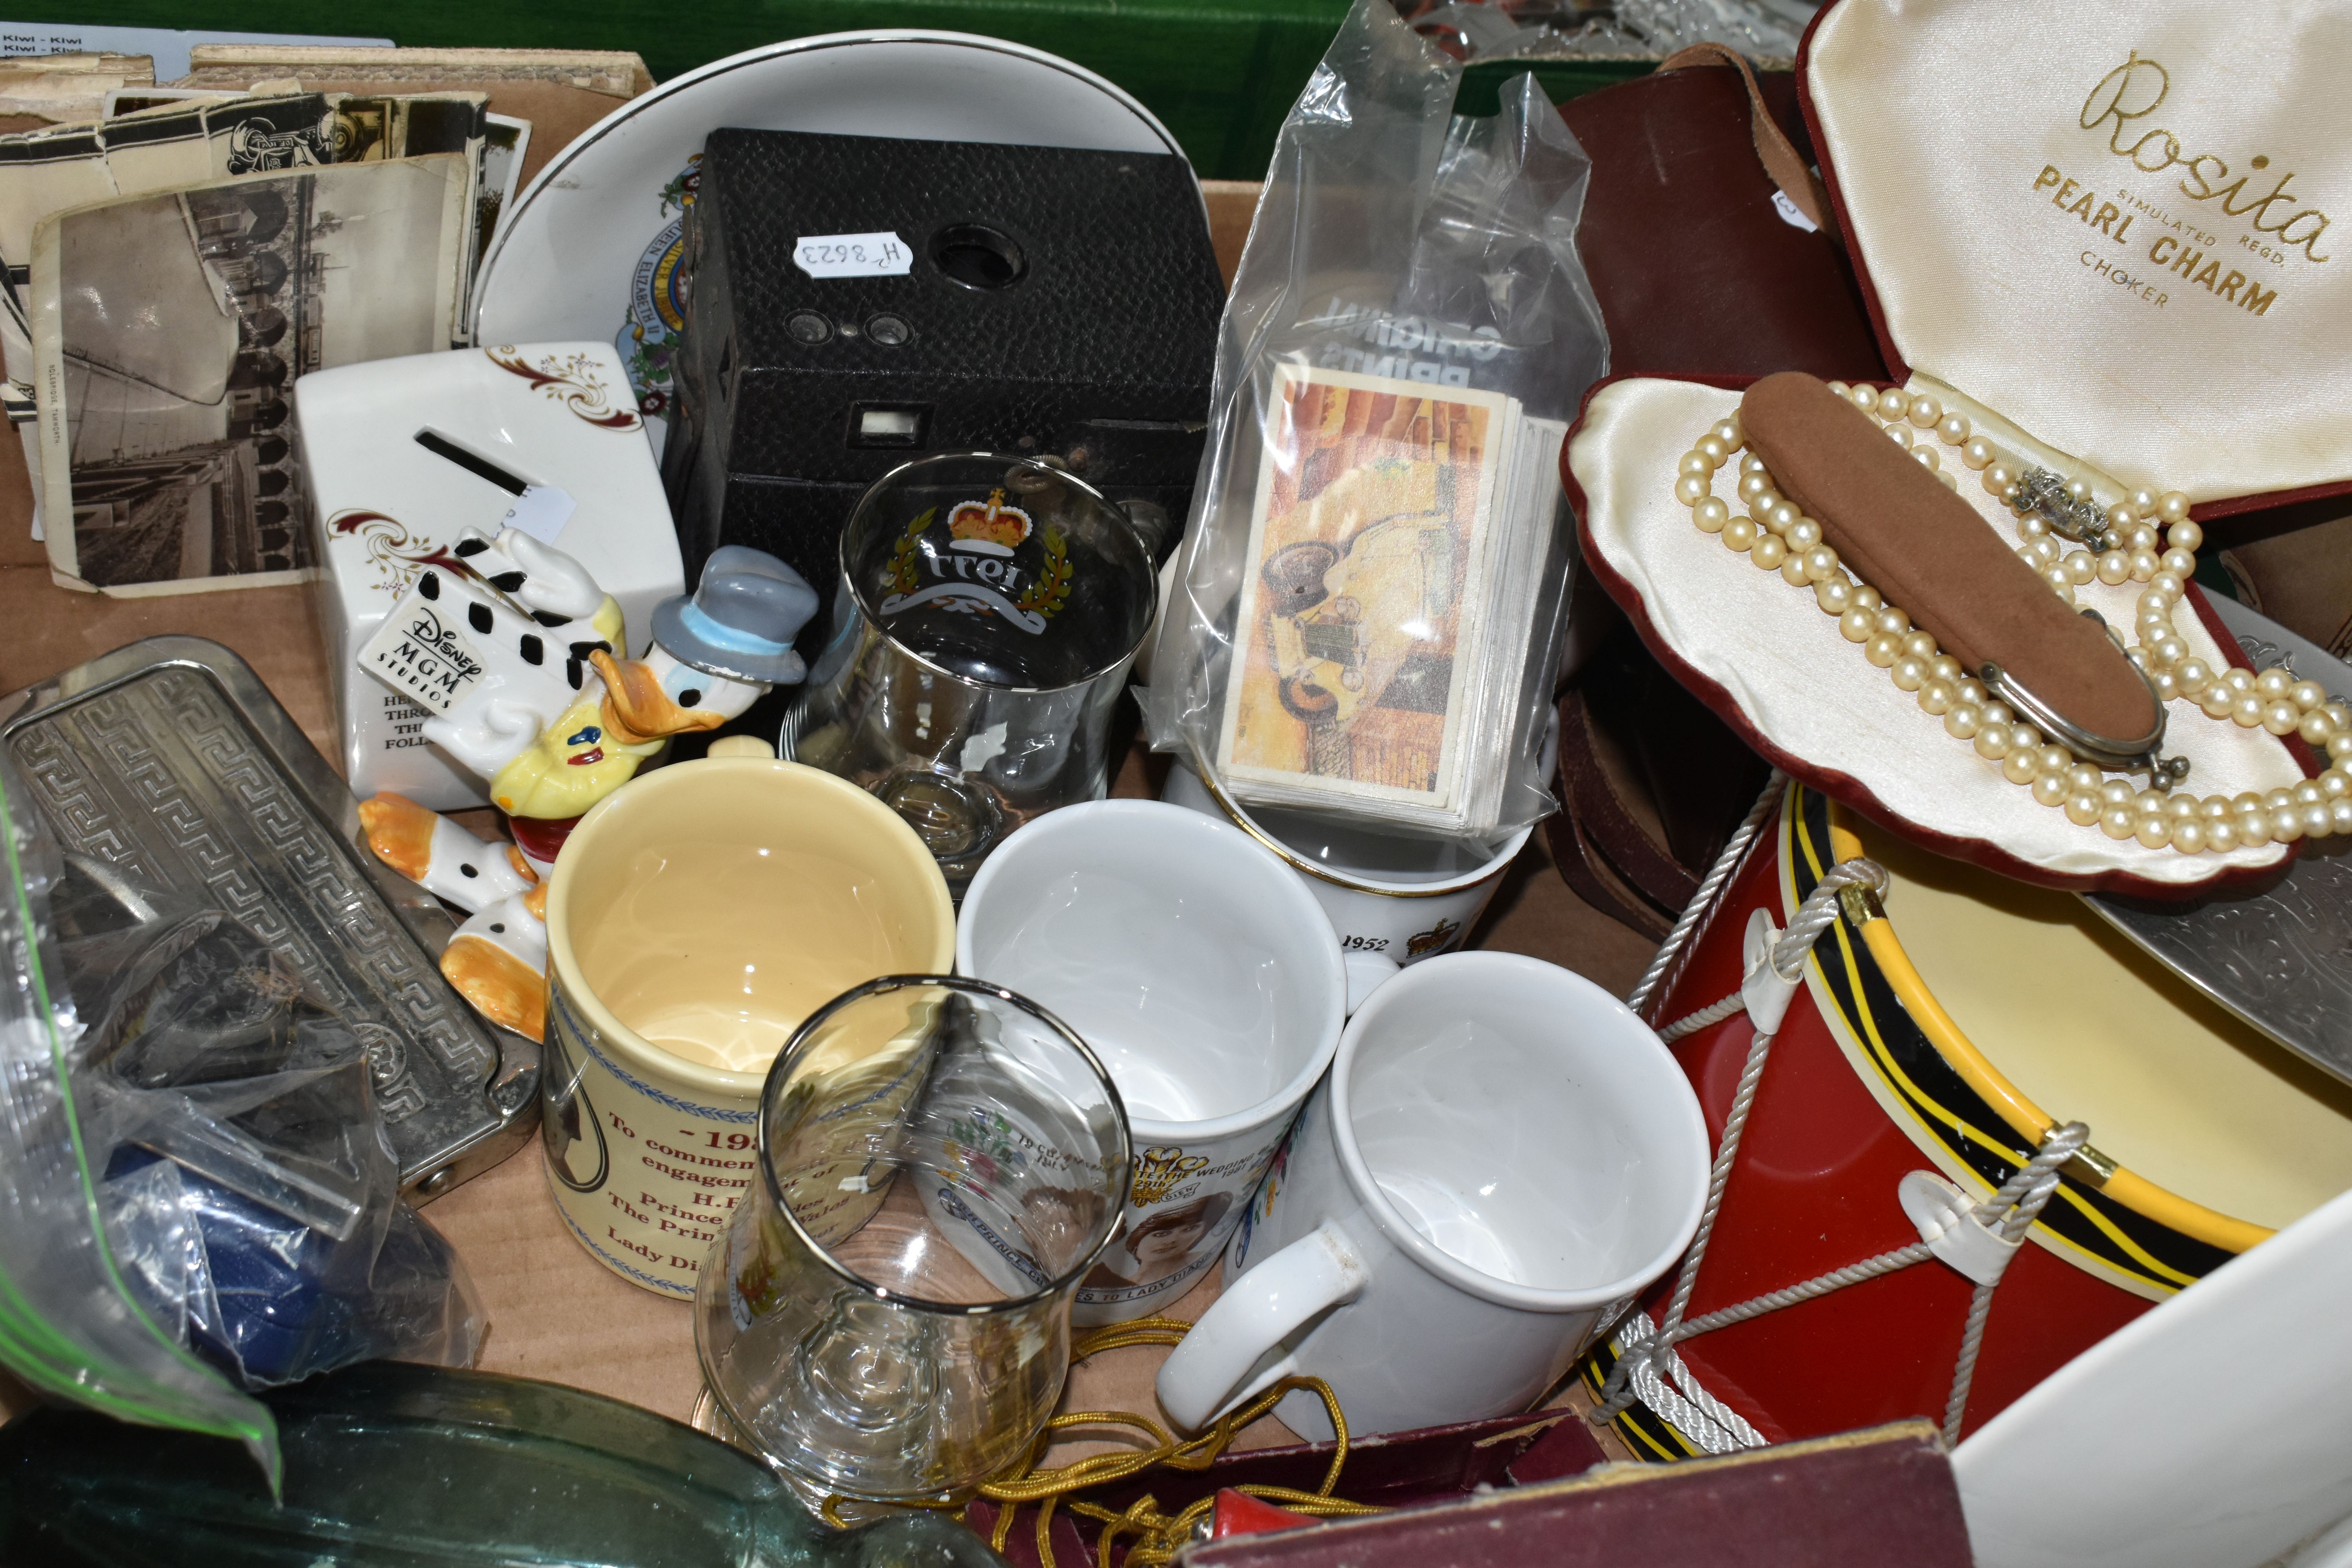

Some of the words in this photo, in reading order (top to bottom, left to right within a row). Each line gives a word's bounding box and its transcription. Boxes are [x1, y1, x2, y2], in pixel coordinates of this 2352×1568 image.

[2080, 49, 2331, 263] Rosita
[2032, 164, 2134, 245] PEARL
[2149, 235, 2278, 316] CHARM
[2116, 189, 2217, 247] SIMULATED
[2239, 234, 2285, 268] REGD.
[802, 245, 867, 263] 8623
[2080, 250, 2170, 308] CHOKER
[636, 261, 655, 323] ELIZABETH
[648, 325, 660, 334] II
[377, 653, 451, 708] STUDIOS
[393, 641, 461, 695] MGM
[384, 695, 411, 706] HE
[385, 708, 431, 720] THRO
[385, 737, 433, 749] FOLL
[1342, 935, 1390, 951] 1952
[609, 1111, 635, 1138] To
[1197, 1153, 1255, 1177] WEDDING
[1221, 1163, 1247, 1178] 1981
[608, 1191, 650, 1224] The
[639, 1191, 723, 1225] Prince
[1166, 1186, 1194, 1200] DIEN
[608, 1225, 664, 1262] Lady
[669, 1255, 701, 1271] Di
[977, 1224, 1023, 1266] PRINCE
[1127, 1281, 1168, 1299] LADY
